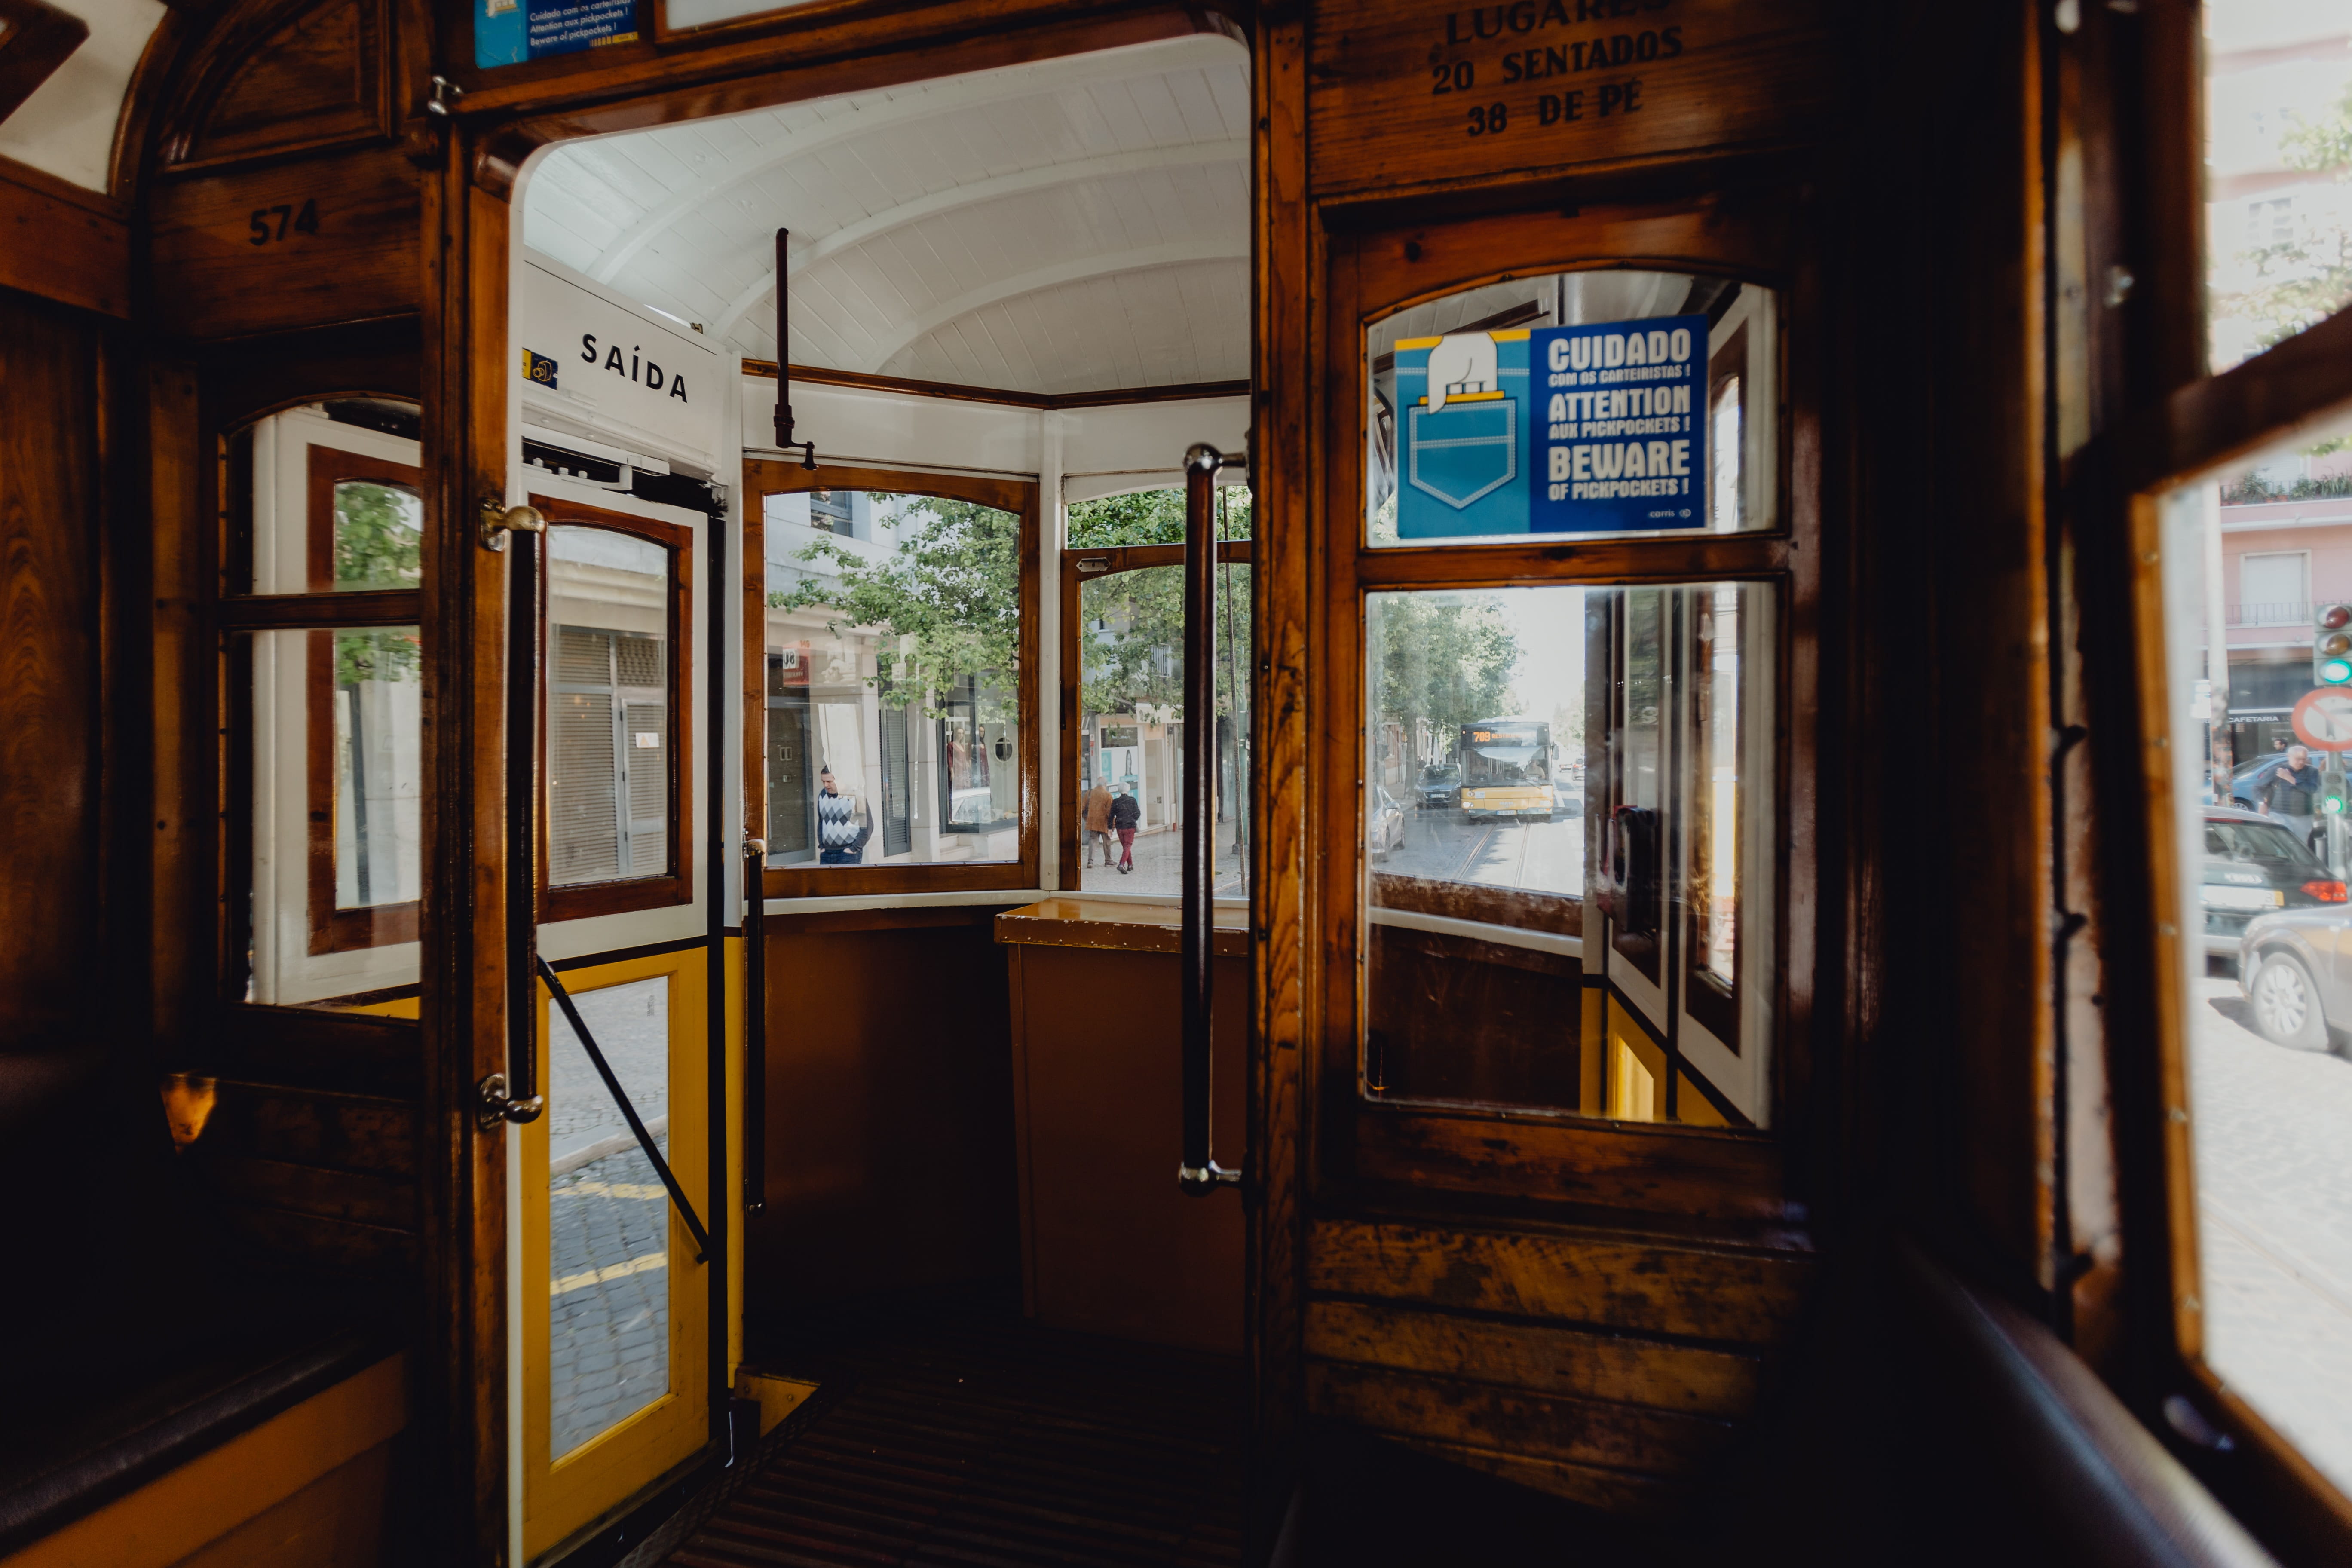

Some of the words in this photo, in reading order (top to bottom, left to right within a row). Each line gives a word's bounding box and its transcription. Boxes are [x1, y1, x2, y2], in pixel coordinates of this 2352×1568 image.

[530, 9, 561, 21] Cuidado
[530, 22, 562, 33] Attention
[564, 18, 578, 27] aux
[580, 9, 623, 26] pickpockets
[530, 34, 558, 46] Beware
[560, 31, 567, 40] of
[569, 24, 612, 40] pickpockets
[1432, 61, 1475, 95] 20
[1502, 26, 1683, 83] SENTADOS
[1467, 102, 1507, 137] 38
[1539, 90, 1585, 126] DE
[249, 199, 318, 246] 574
[1548, 328, 1691, 372] CUIDADO
[1549, 372, 1577, 387] COM
[1579, 371, 1596, 386] OS
[1599, 365, 1682, 384] CARTEIRISTAS
[1685, 364, 1690, 376] !
[1549, 385, 1690, 423] ATTENTION
[1549, 423, 1578, 440] AUX
[1581, 416, 1680, 438] PICKPOCKETS
[1684, 416, 1690, 432] !
[1549, 440, 1690, 482] BEWARE
[1549, 483, 1568, 501] OF
[1571, 478, 1678, 500] PICKPOCKETS
[1682, 478, 1689, 495] !
[1650, 509, 1675, 518] carris
[1473, 732, 1491, 742] 709
